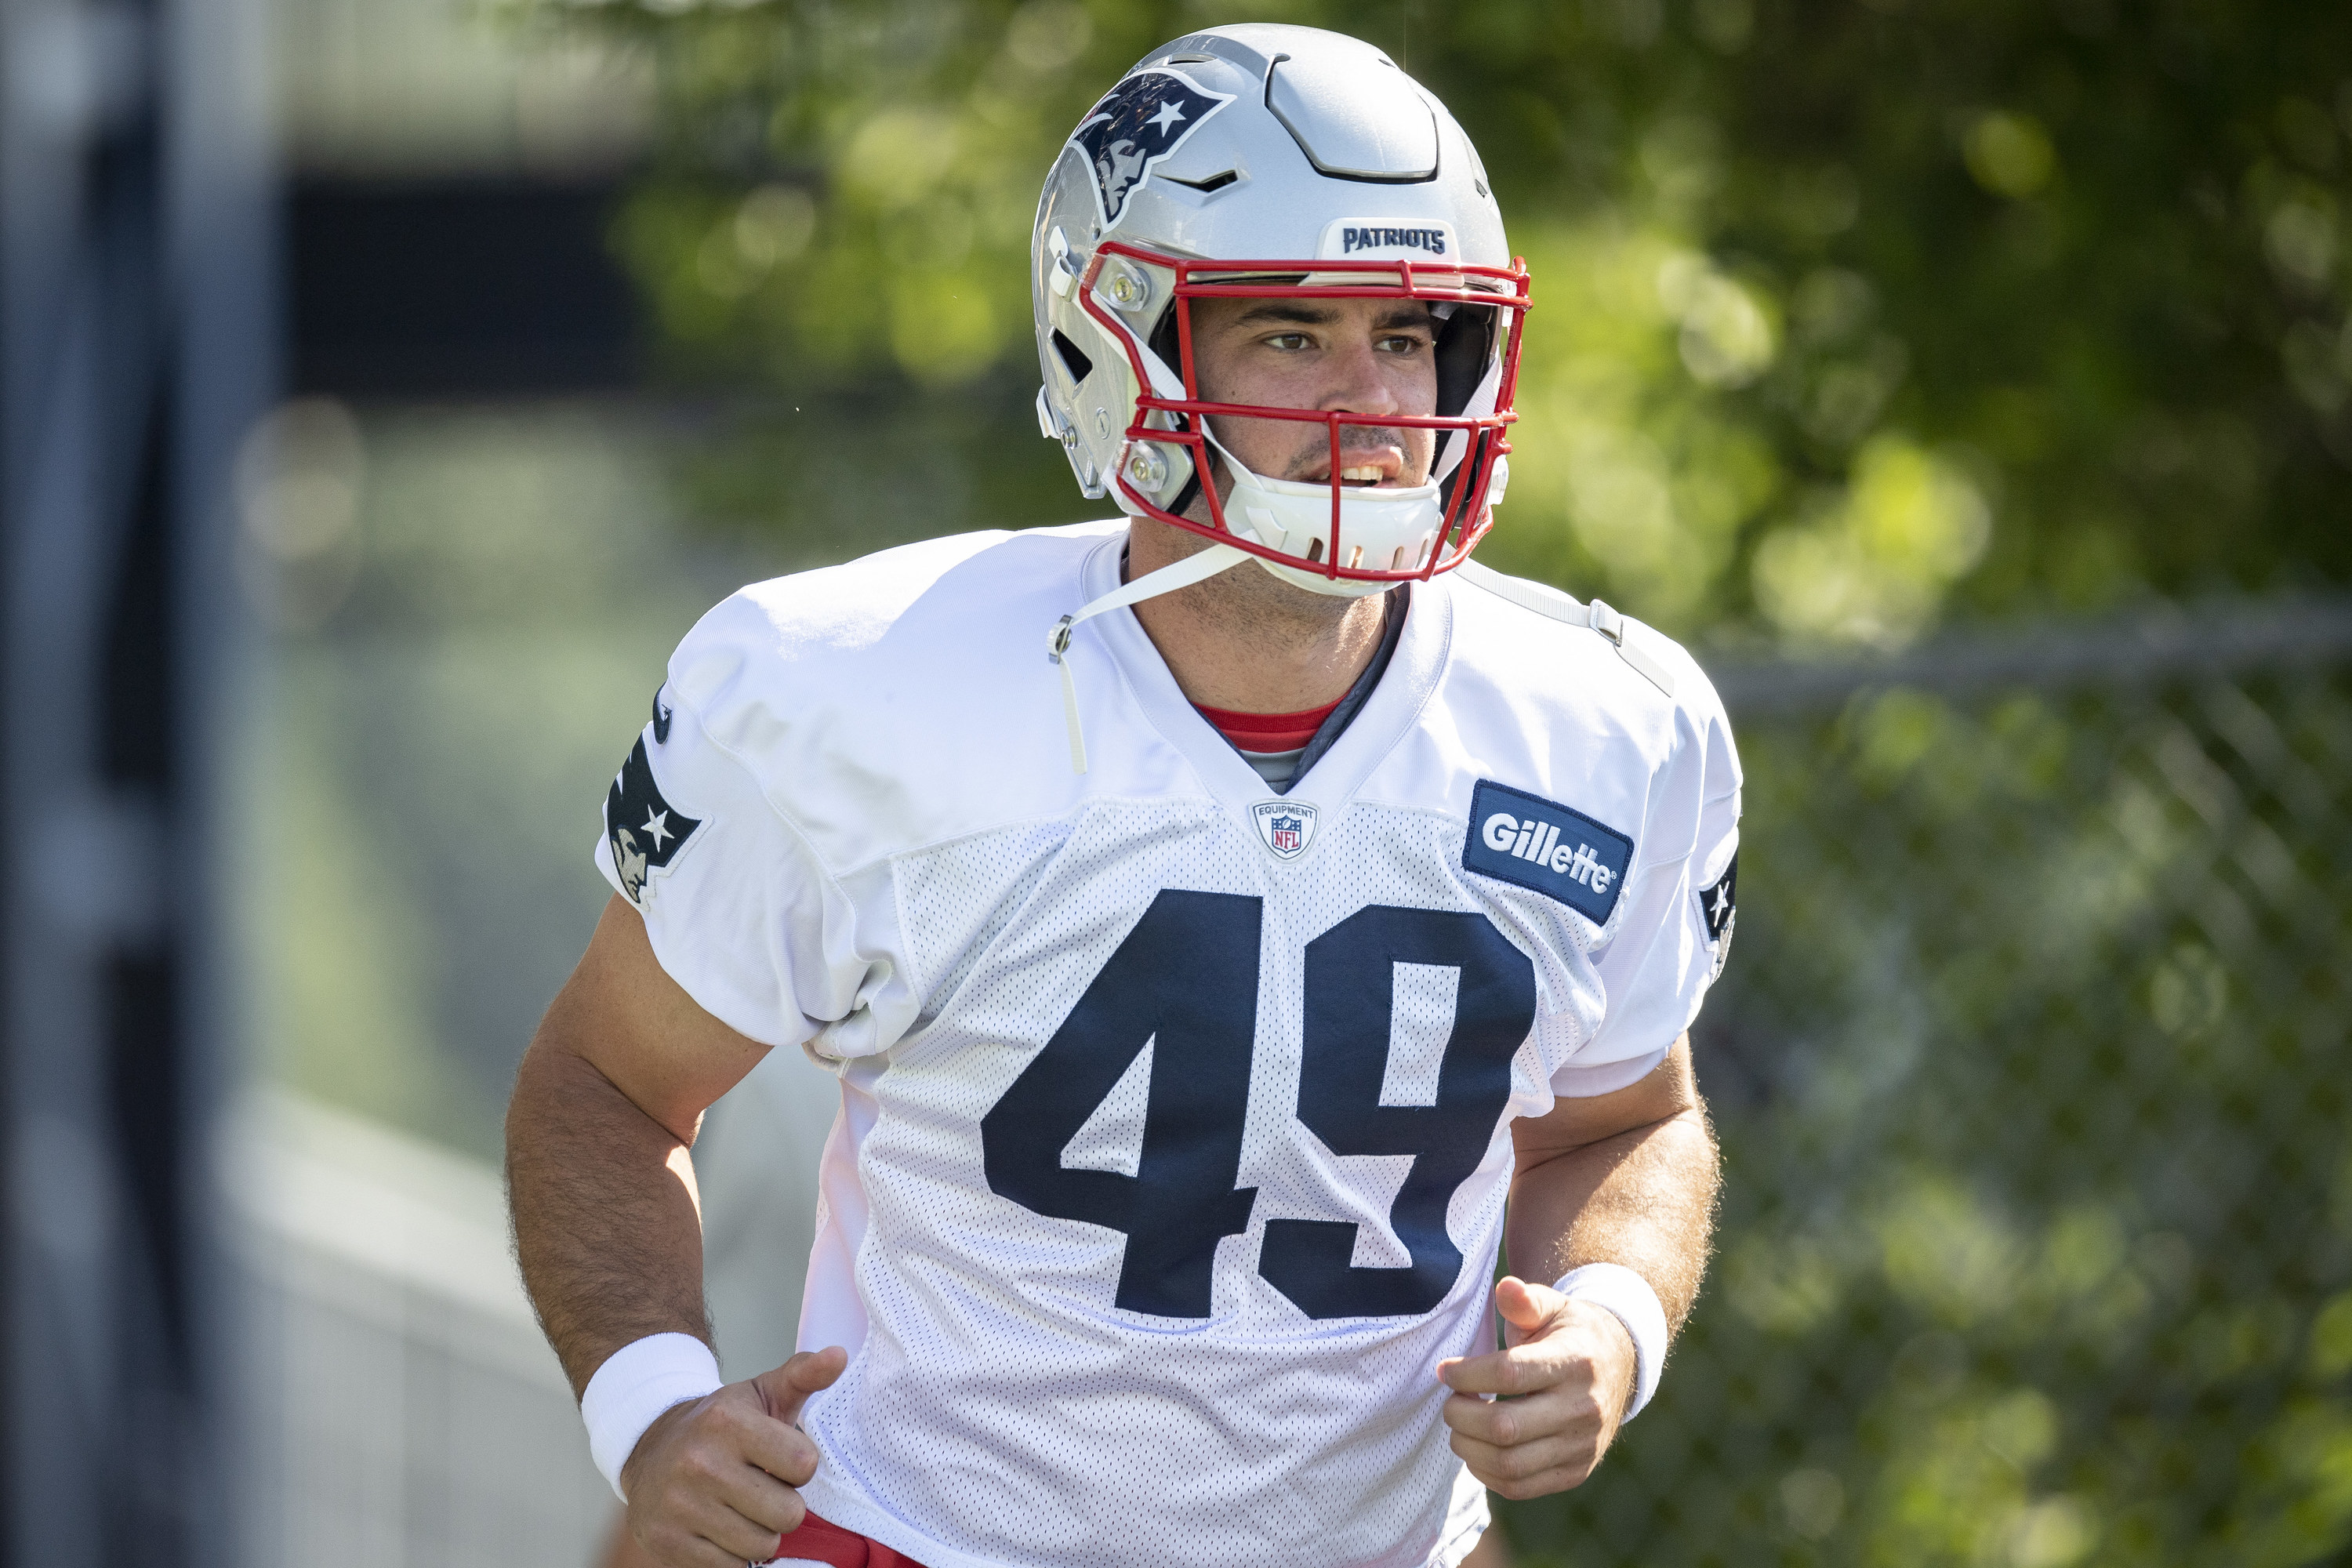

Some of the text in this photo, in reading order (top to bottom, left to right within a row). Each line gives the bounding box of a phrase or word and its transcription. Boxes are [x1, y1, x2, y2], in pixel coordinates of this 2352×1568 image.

[1343, 227, 1446, 255] PATRIOTS
[1258, 805, 1313, 819] EQUIPMENT
[1274, 830, 1299, 850] NFL
[981, 888, 1537, 1320] 49
